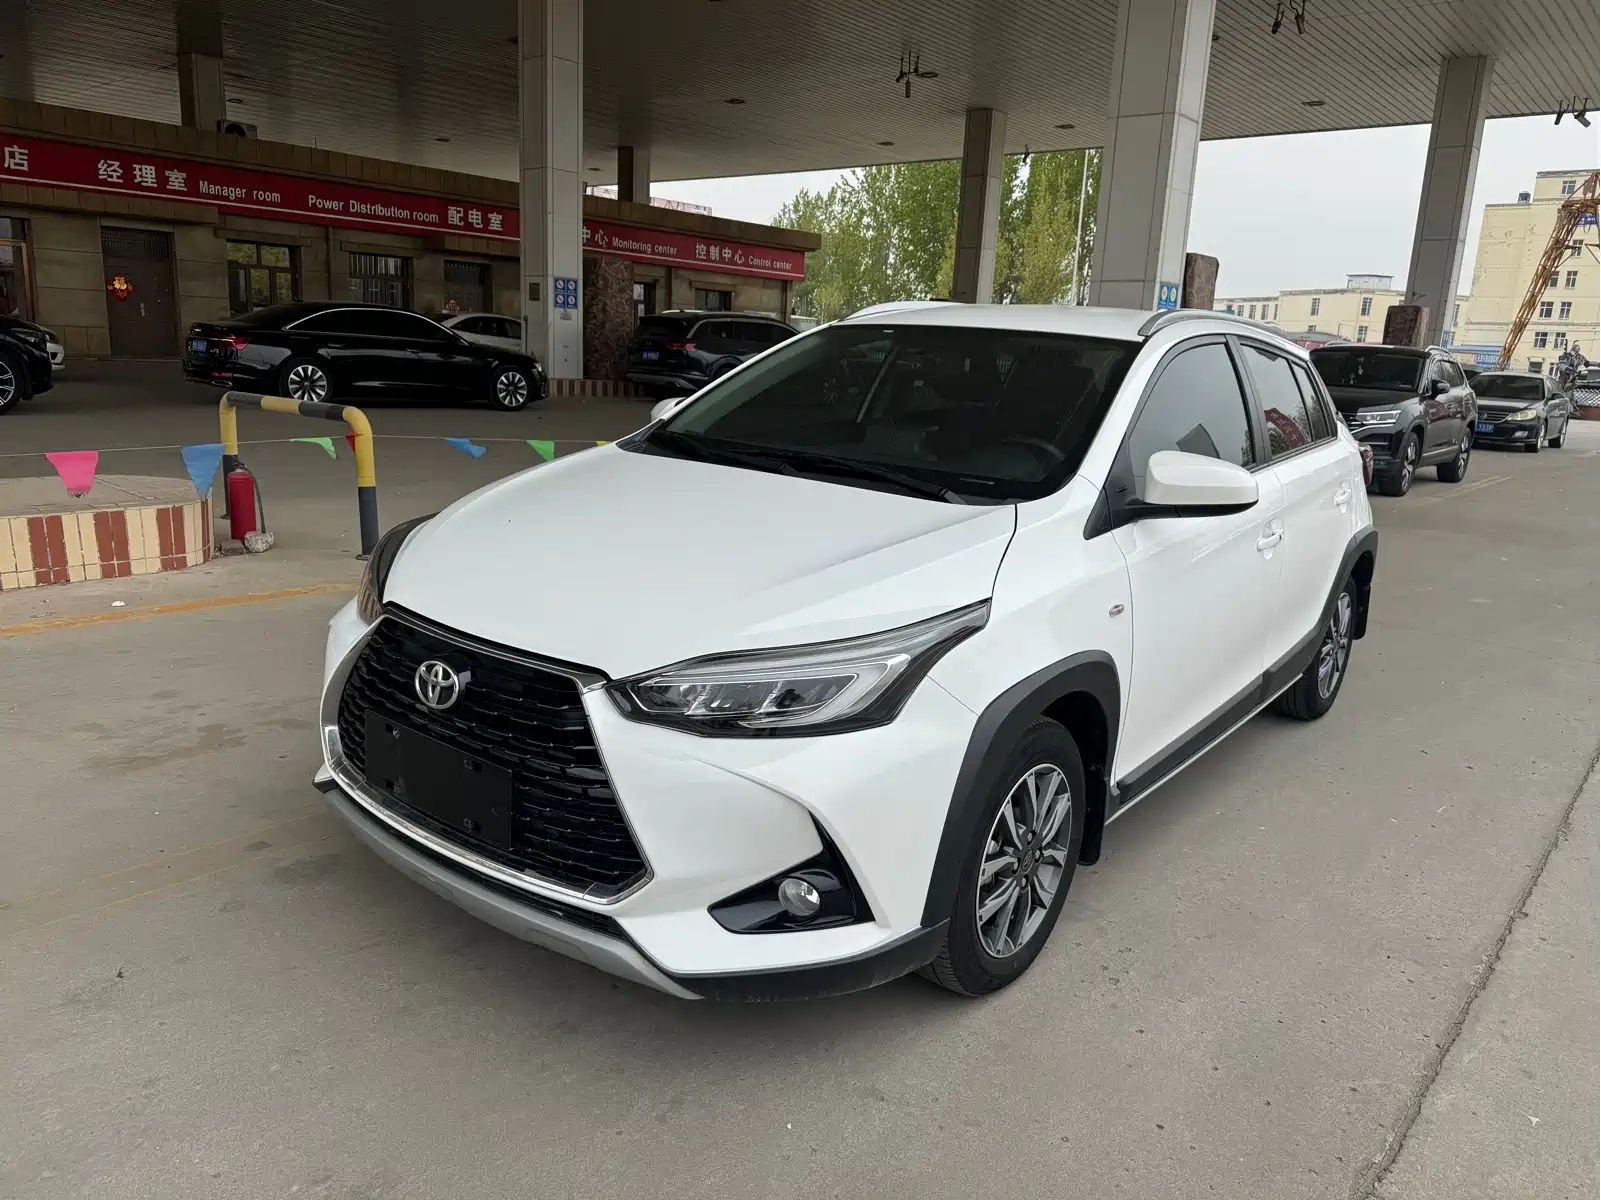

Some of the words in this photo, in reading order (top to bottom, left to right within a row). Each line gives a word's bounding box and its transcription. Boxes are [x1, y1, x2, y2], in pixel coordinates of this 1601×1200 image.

[4, 144, 29, 172] 店
[97, 158, 188, 192] 经理室
[199, 180, 246, 200] Manager
[252, 190, 281, 203] room
[308, 195, 344, 212] Power
[349, 200, 410, 220] Distribution
[412, 210, 439, 223] room
[447, 205, 503, 232] 配电室
[612, 236, 652, 254] Monitoring
[654, 244, 678, 256] center
[695, 242, 745, 264] 控制中心
[773, 260, 792, 271] center
